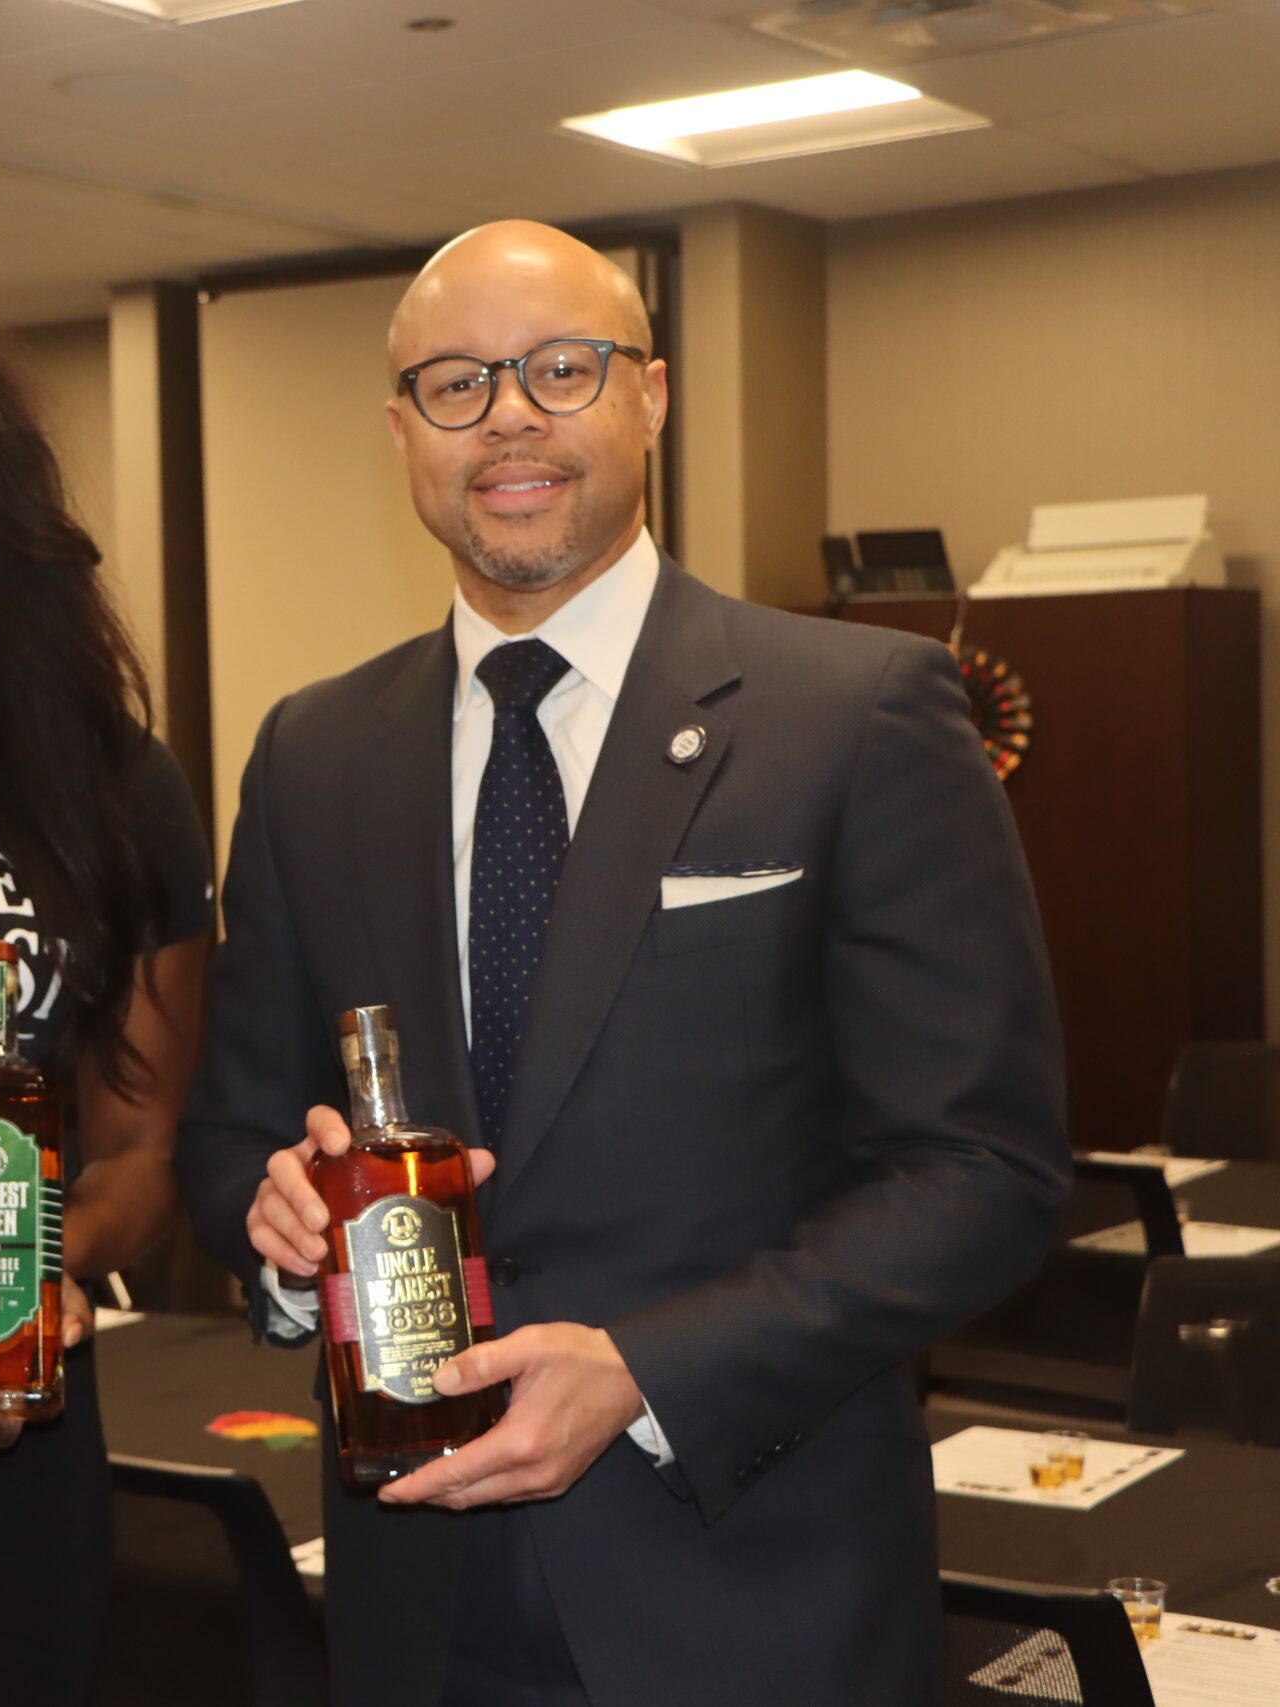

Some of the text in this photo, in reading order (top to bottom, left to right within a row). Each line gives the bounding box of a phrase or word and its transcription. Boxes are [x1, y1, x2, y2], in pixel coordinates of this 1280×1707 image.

[376, 1247, 438, 1278] UNCLE
[367, 1272, 451, 1307] NEAREST
[370, 1299, 456, 1336] 1856
